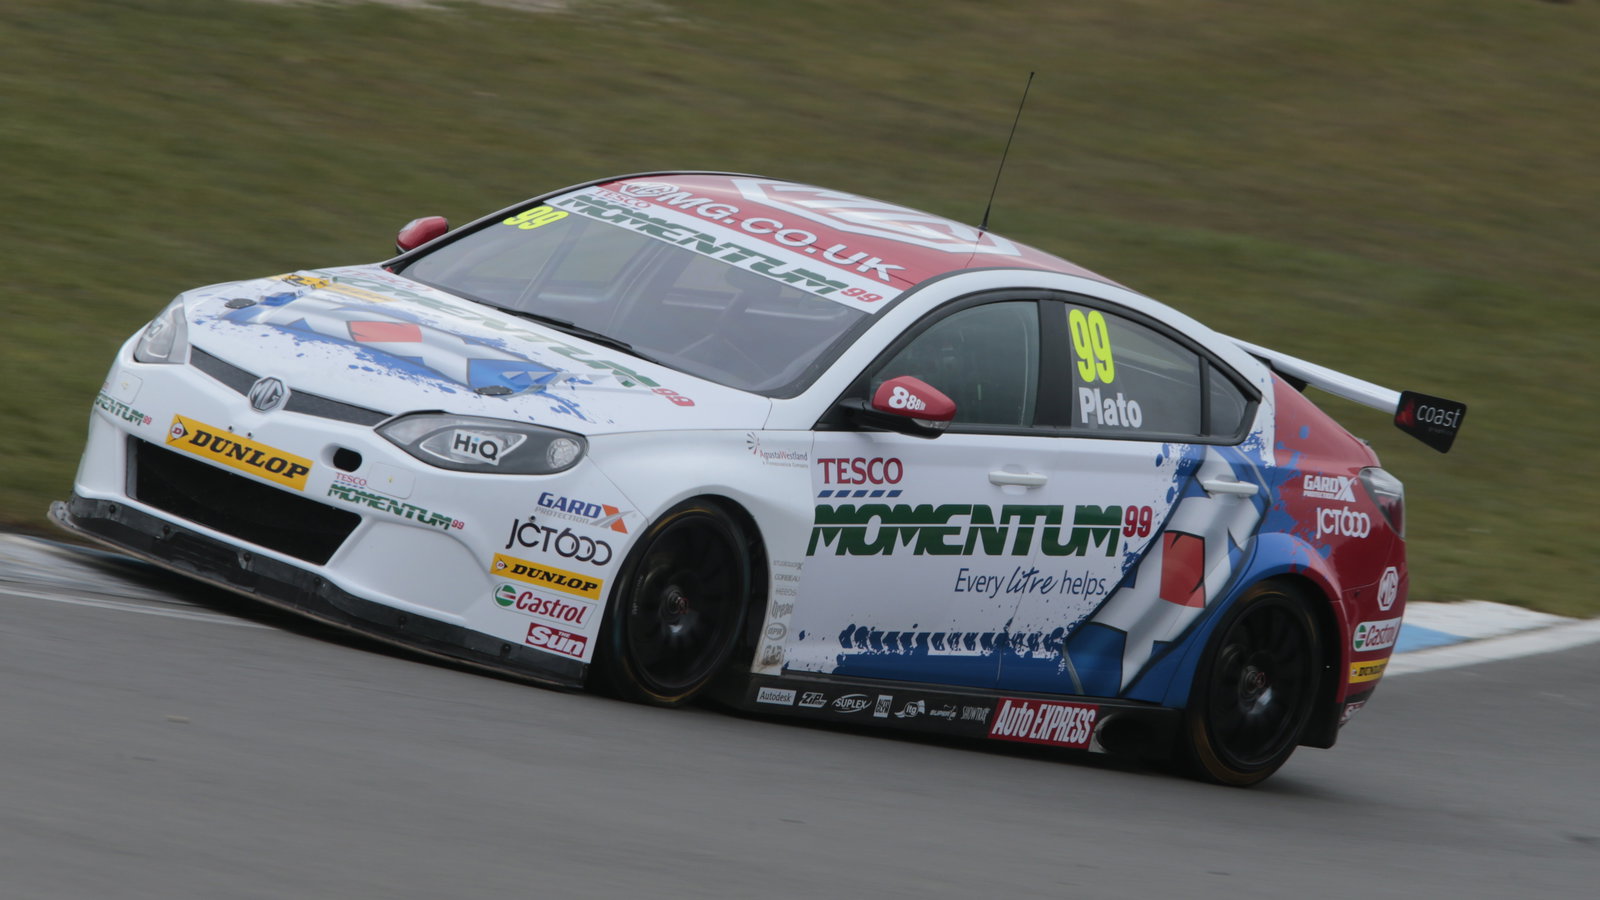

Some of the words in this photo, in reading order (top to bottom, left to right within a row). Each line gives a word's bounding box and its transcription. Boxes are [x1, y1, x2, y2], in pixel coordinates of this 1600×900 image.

[595, 189, 651, 208] TESCO
[503, 205, 569, 230] 99
[557, 194, 850, 296] MOMENTUM
[841, 287, 883, 302] 99
[656, 191, 905, 283] MG.CO.UK
[1069, 309, 1115, 384] 99
[651, 388, 695, 407] 99
[1078, 387, 1142, 429] Plato
[1416, 405, 1461, 428] coast
[188, 430, 309, 479] DUNLOP
[453, 433, 498, 461] HiQ
[336, 472, 367, 486] TESCO
[817, 457, 904, 485] TESCO
[327, 484, 452, 530] MOMENTUM
[451, 520, 465, 530] 99
[1316, 506, 1370, 540] JCT600
[506, 515, 612, 566] JCT600
[806, 504, 1123, 557] MOMENTUM
[1123, 506, 1152, 538] 99
[511, 564, 598, 592] DUNLOP
[954, 568, 1005, 598] Every
[1006, 566, 1058, 594] litre
[1060, 569, 1108, 600] helps.
[516, 592, 587, 624] Castrol
[529, 626, 586, 657] Sun
[761, 691, 791, 702] Autodesk
[835, 698, 867, 709] SUPLEX
[992, 700, 1035, 737] Auto
[1029, 704, 1096, 744] EXPRESS
